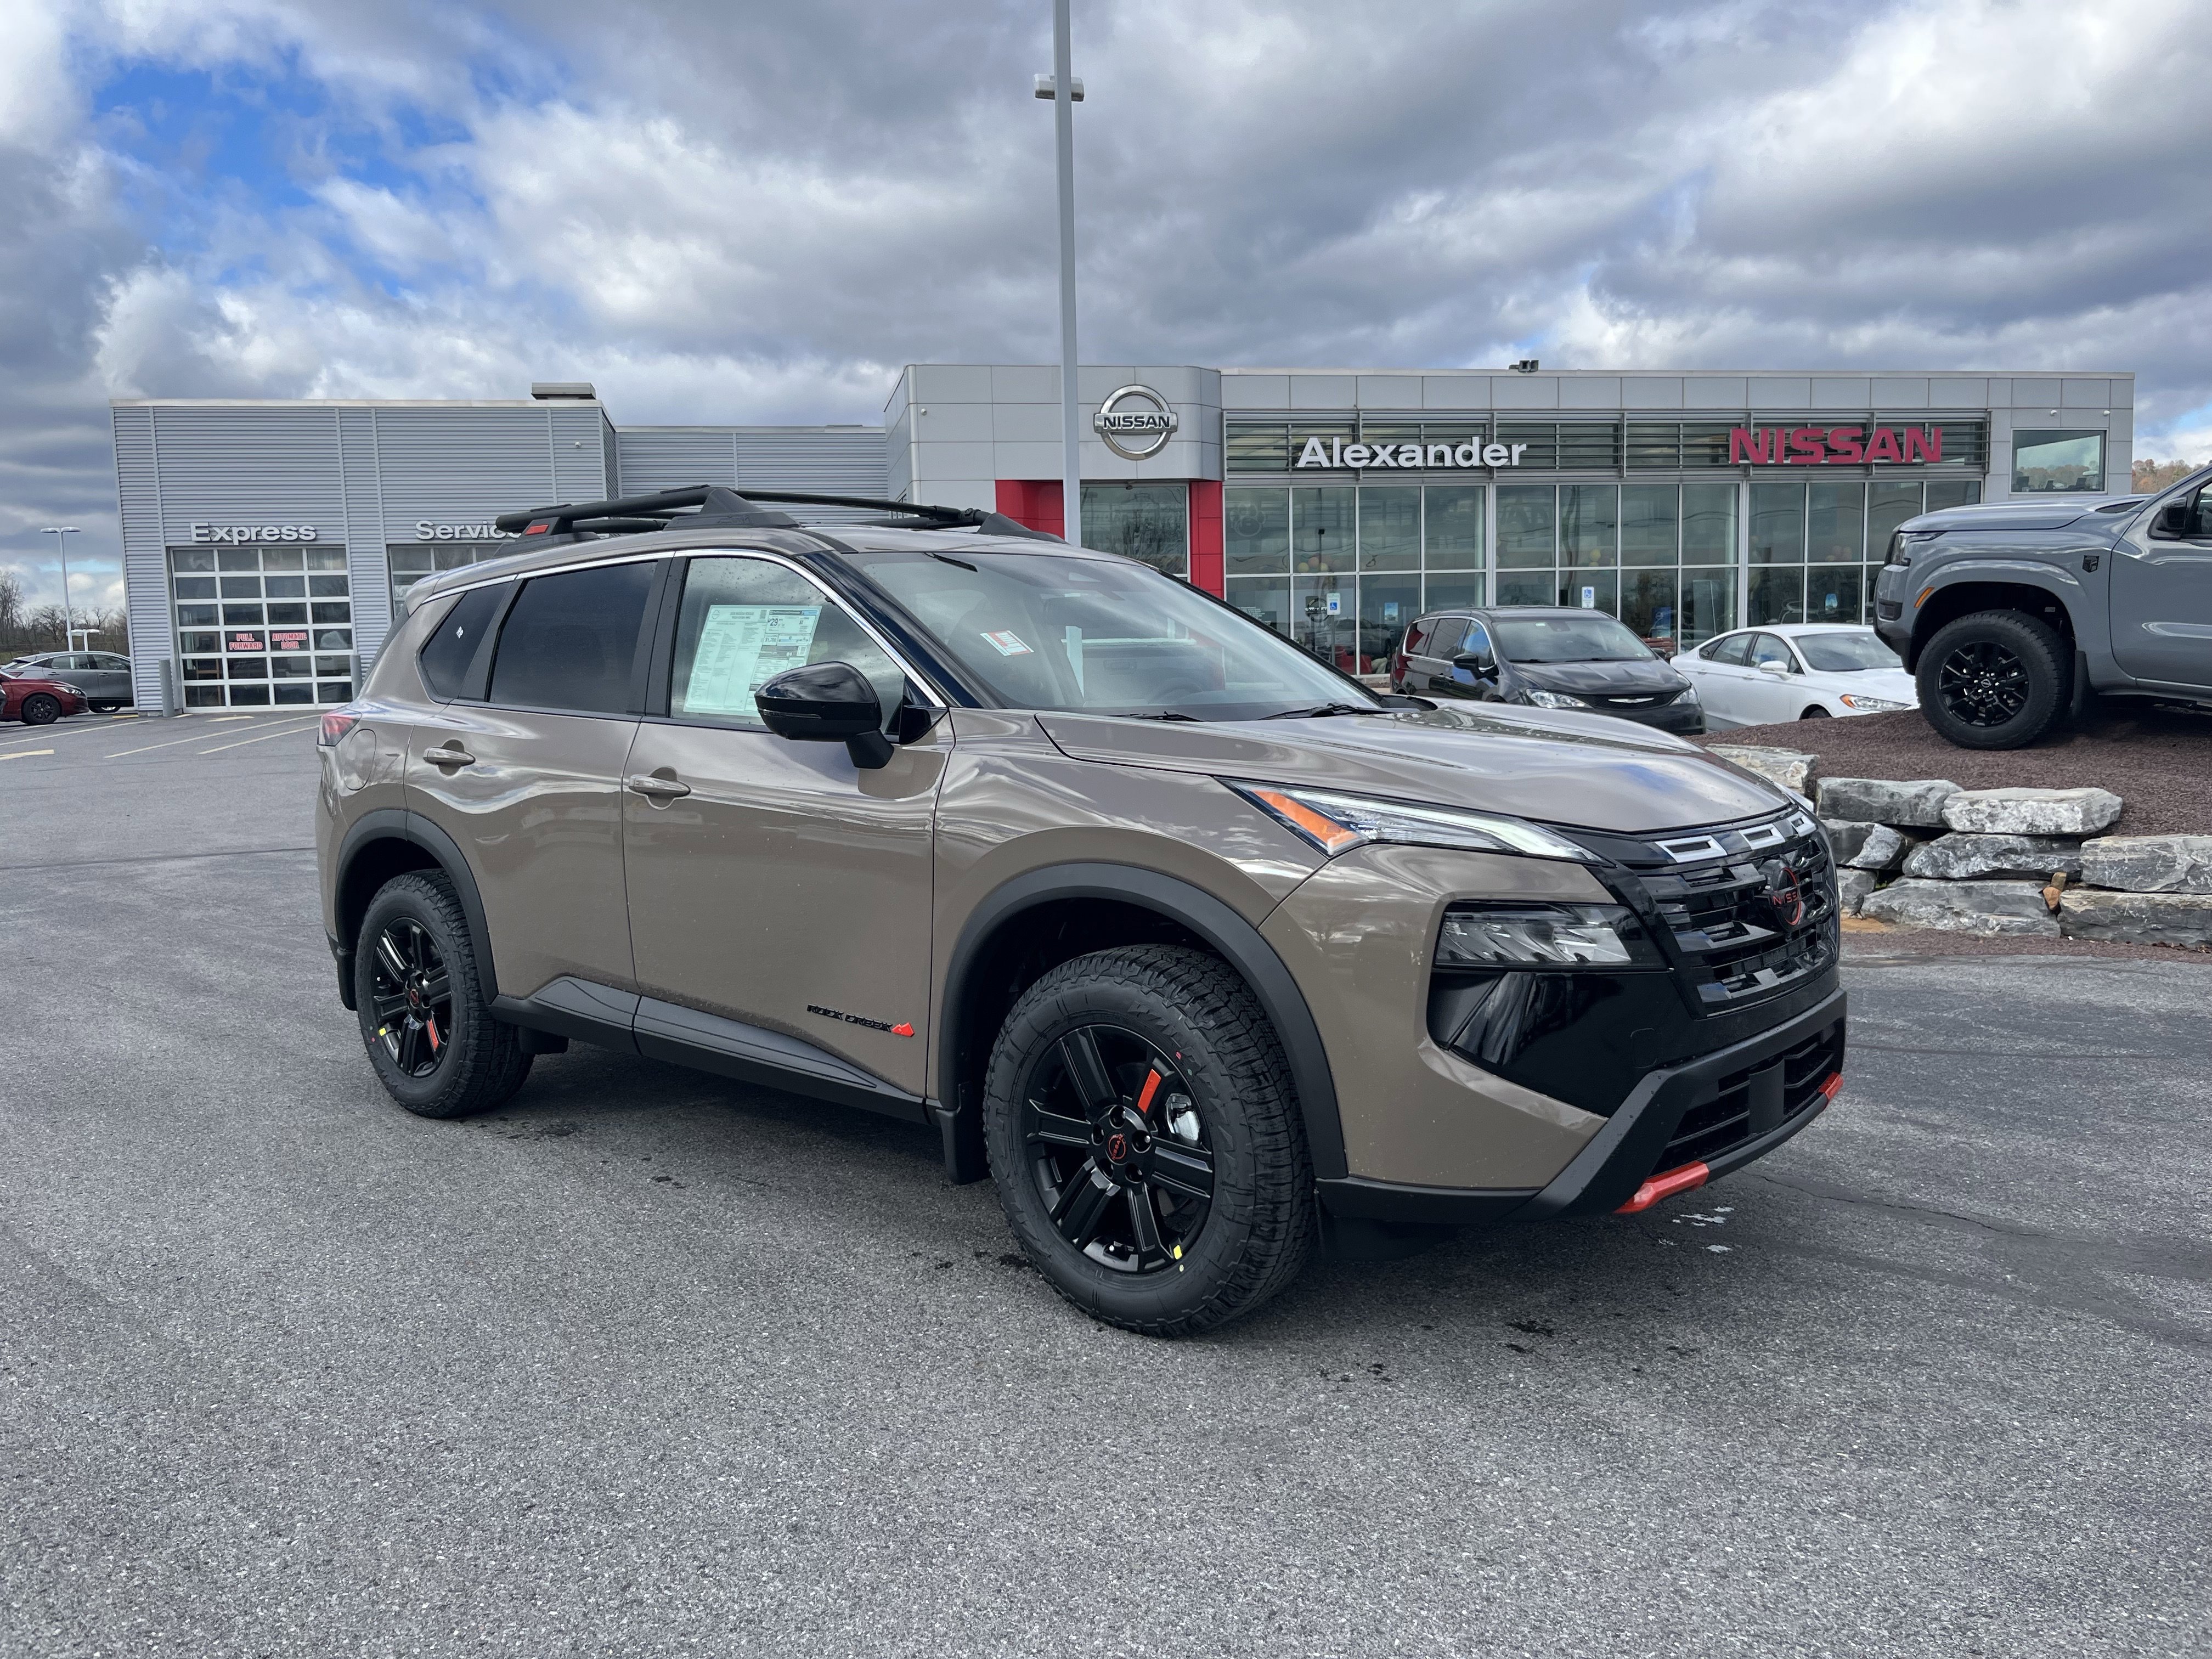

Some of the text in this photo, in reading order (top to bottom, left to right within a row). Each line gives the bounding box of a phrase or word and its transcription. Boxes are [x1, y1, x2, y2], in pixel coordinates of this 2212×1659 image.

[1103, 415, 1171, 430] NISSAN
[1296, 436, 1527, 468] Alexander
[1729, 427, 1943, 465] NISSAN
[190, 522, 317, 546] Express
[229, 641, 263, 650] FORWARD
[236, 633, 255, 641] PULL
[272, 633, 307, 641] AUTOMATIC
[807, 1003, 893, 1032] ROCK CREEK
